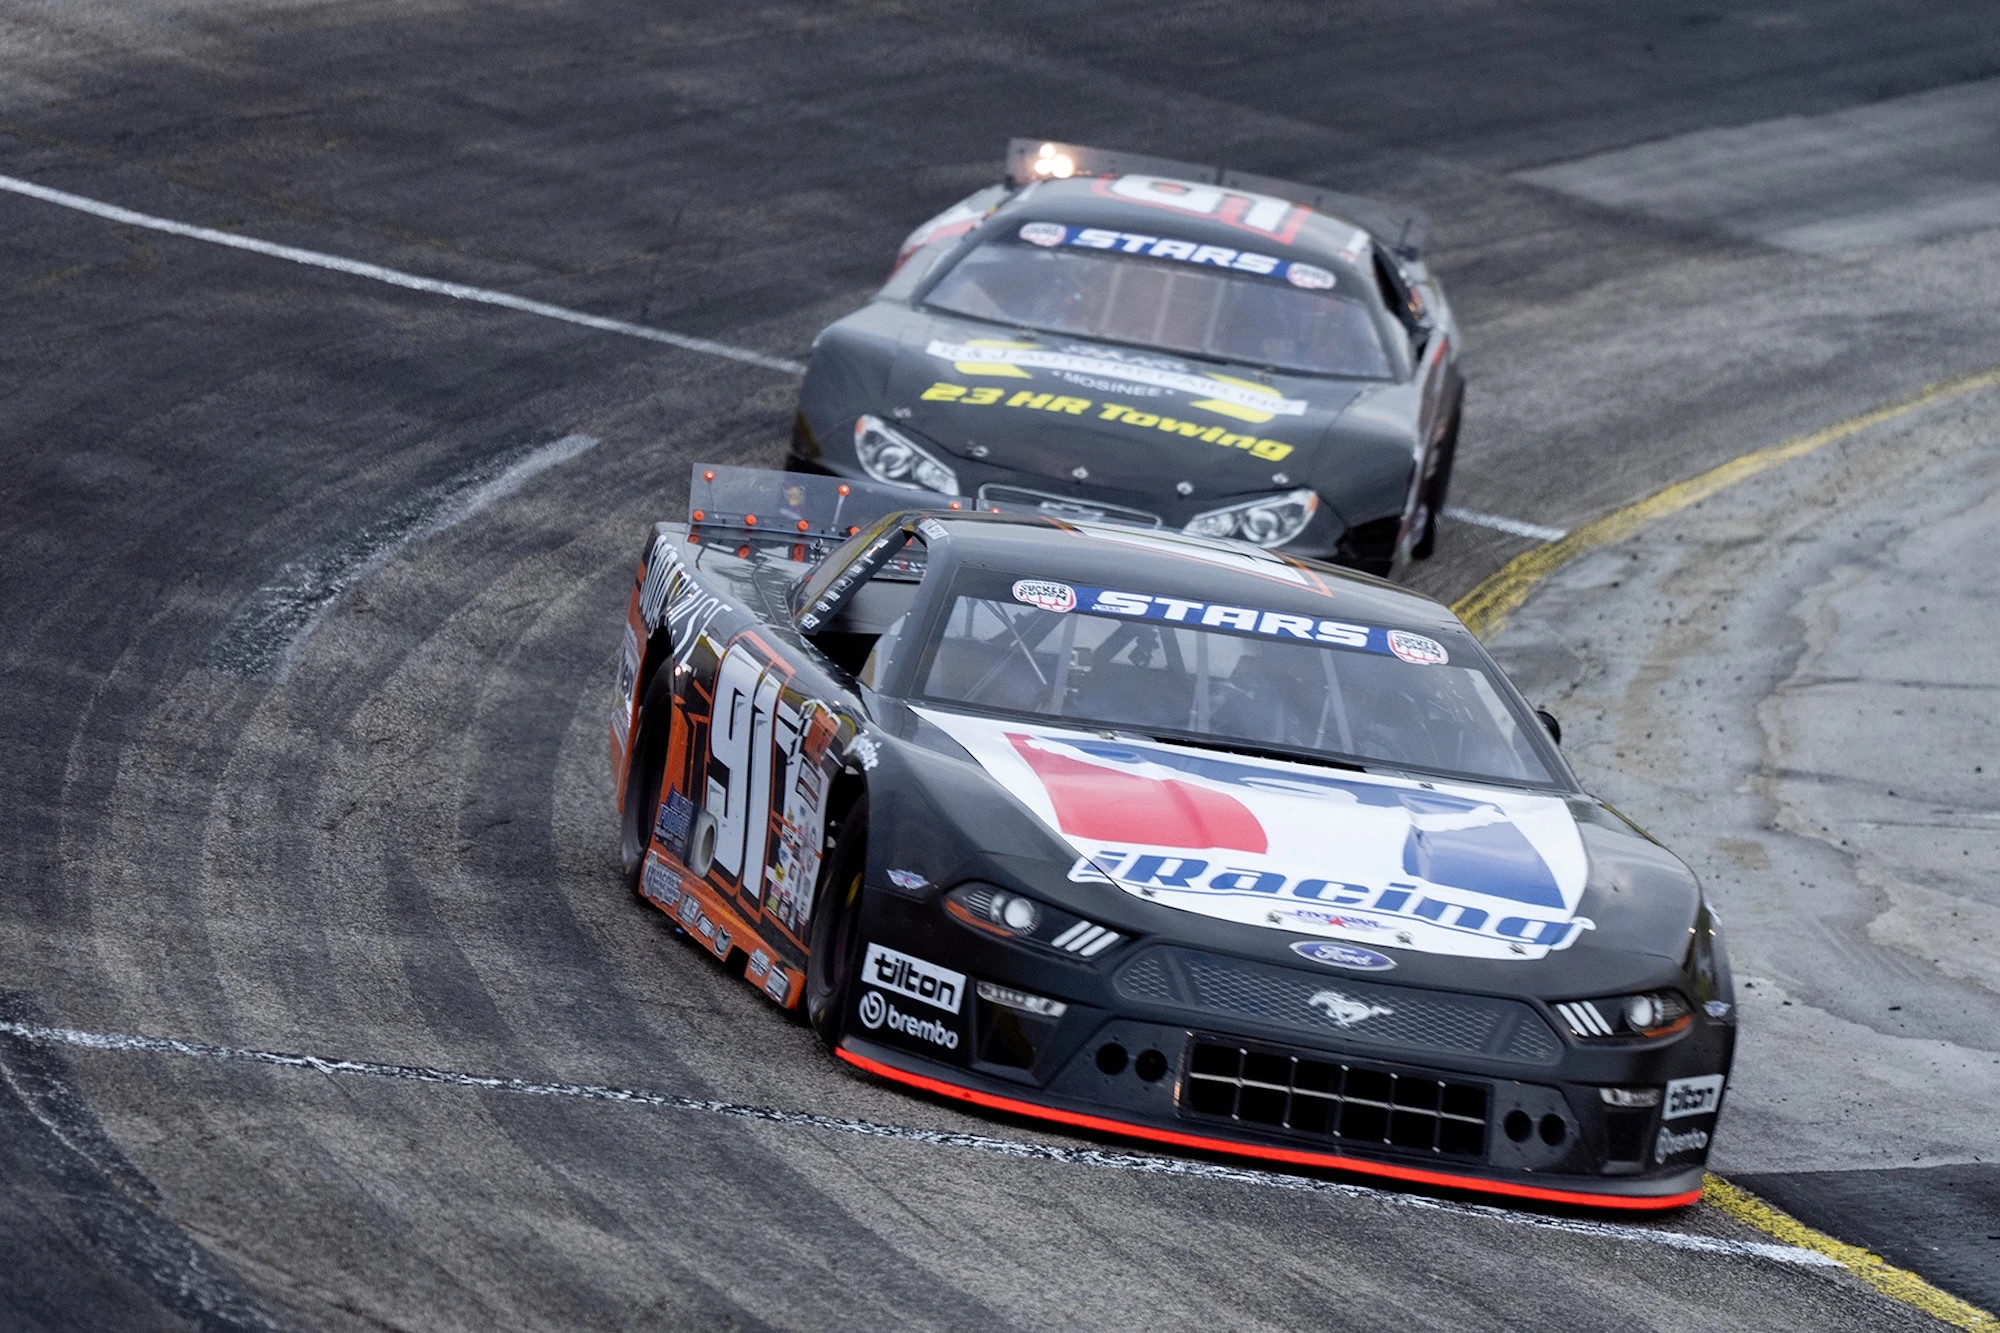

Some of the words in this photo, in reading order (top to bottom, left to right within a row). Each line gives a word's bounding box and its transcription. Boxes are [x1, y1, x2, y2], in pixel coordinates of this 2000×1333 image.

[1071, 228, 1282, 275] STARS
[1062, 371, 1162, 397] MOSINEE
[920, 382, 1005, 405] 23
[1005, 391, 1092, 416] HR
[1098, 402, 1295, 462] Towing
[1019, 583, 1067, 598] SUCKER
[1096, 590, 1370, 648] STARS
[705, 642, 782, 900] 91
[1081, 850, 1576, 948] iRacing
[874, 952, 956, 1007] tilton
[1314, 944, 1373, 967] Ford
[886, 1004, 960, 1050] brembo
